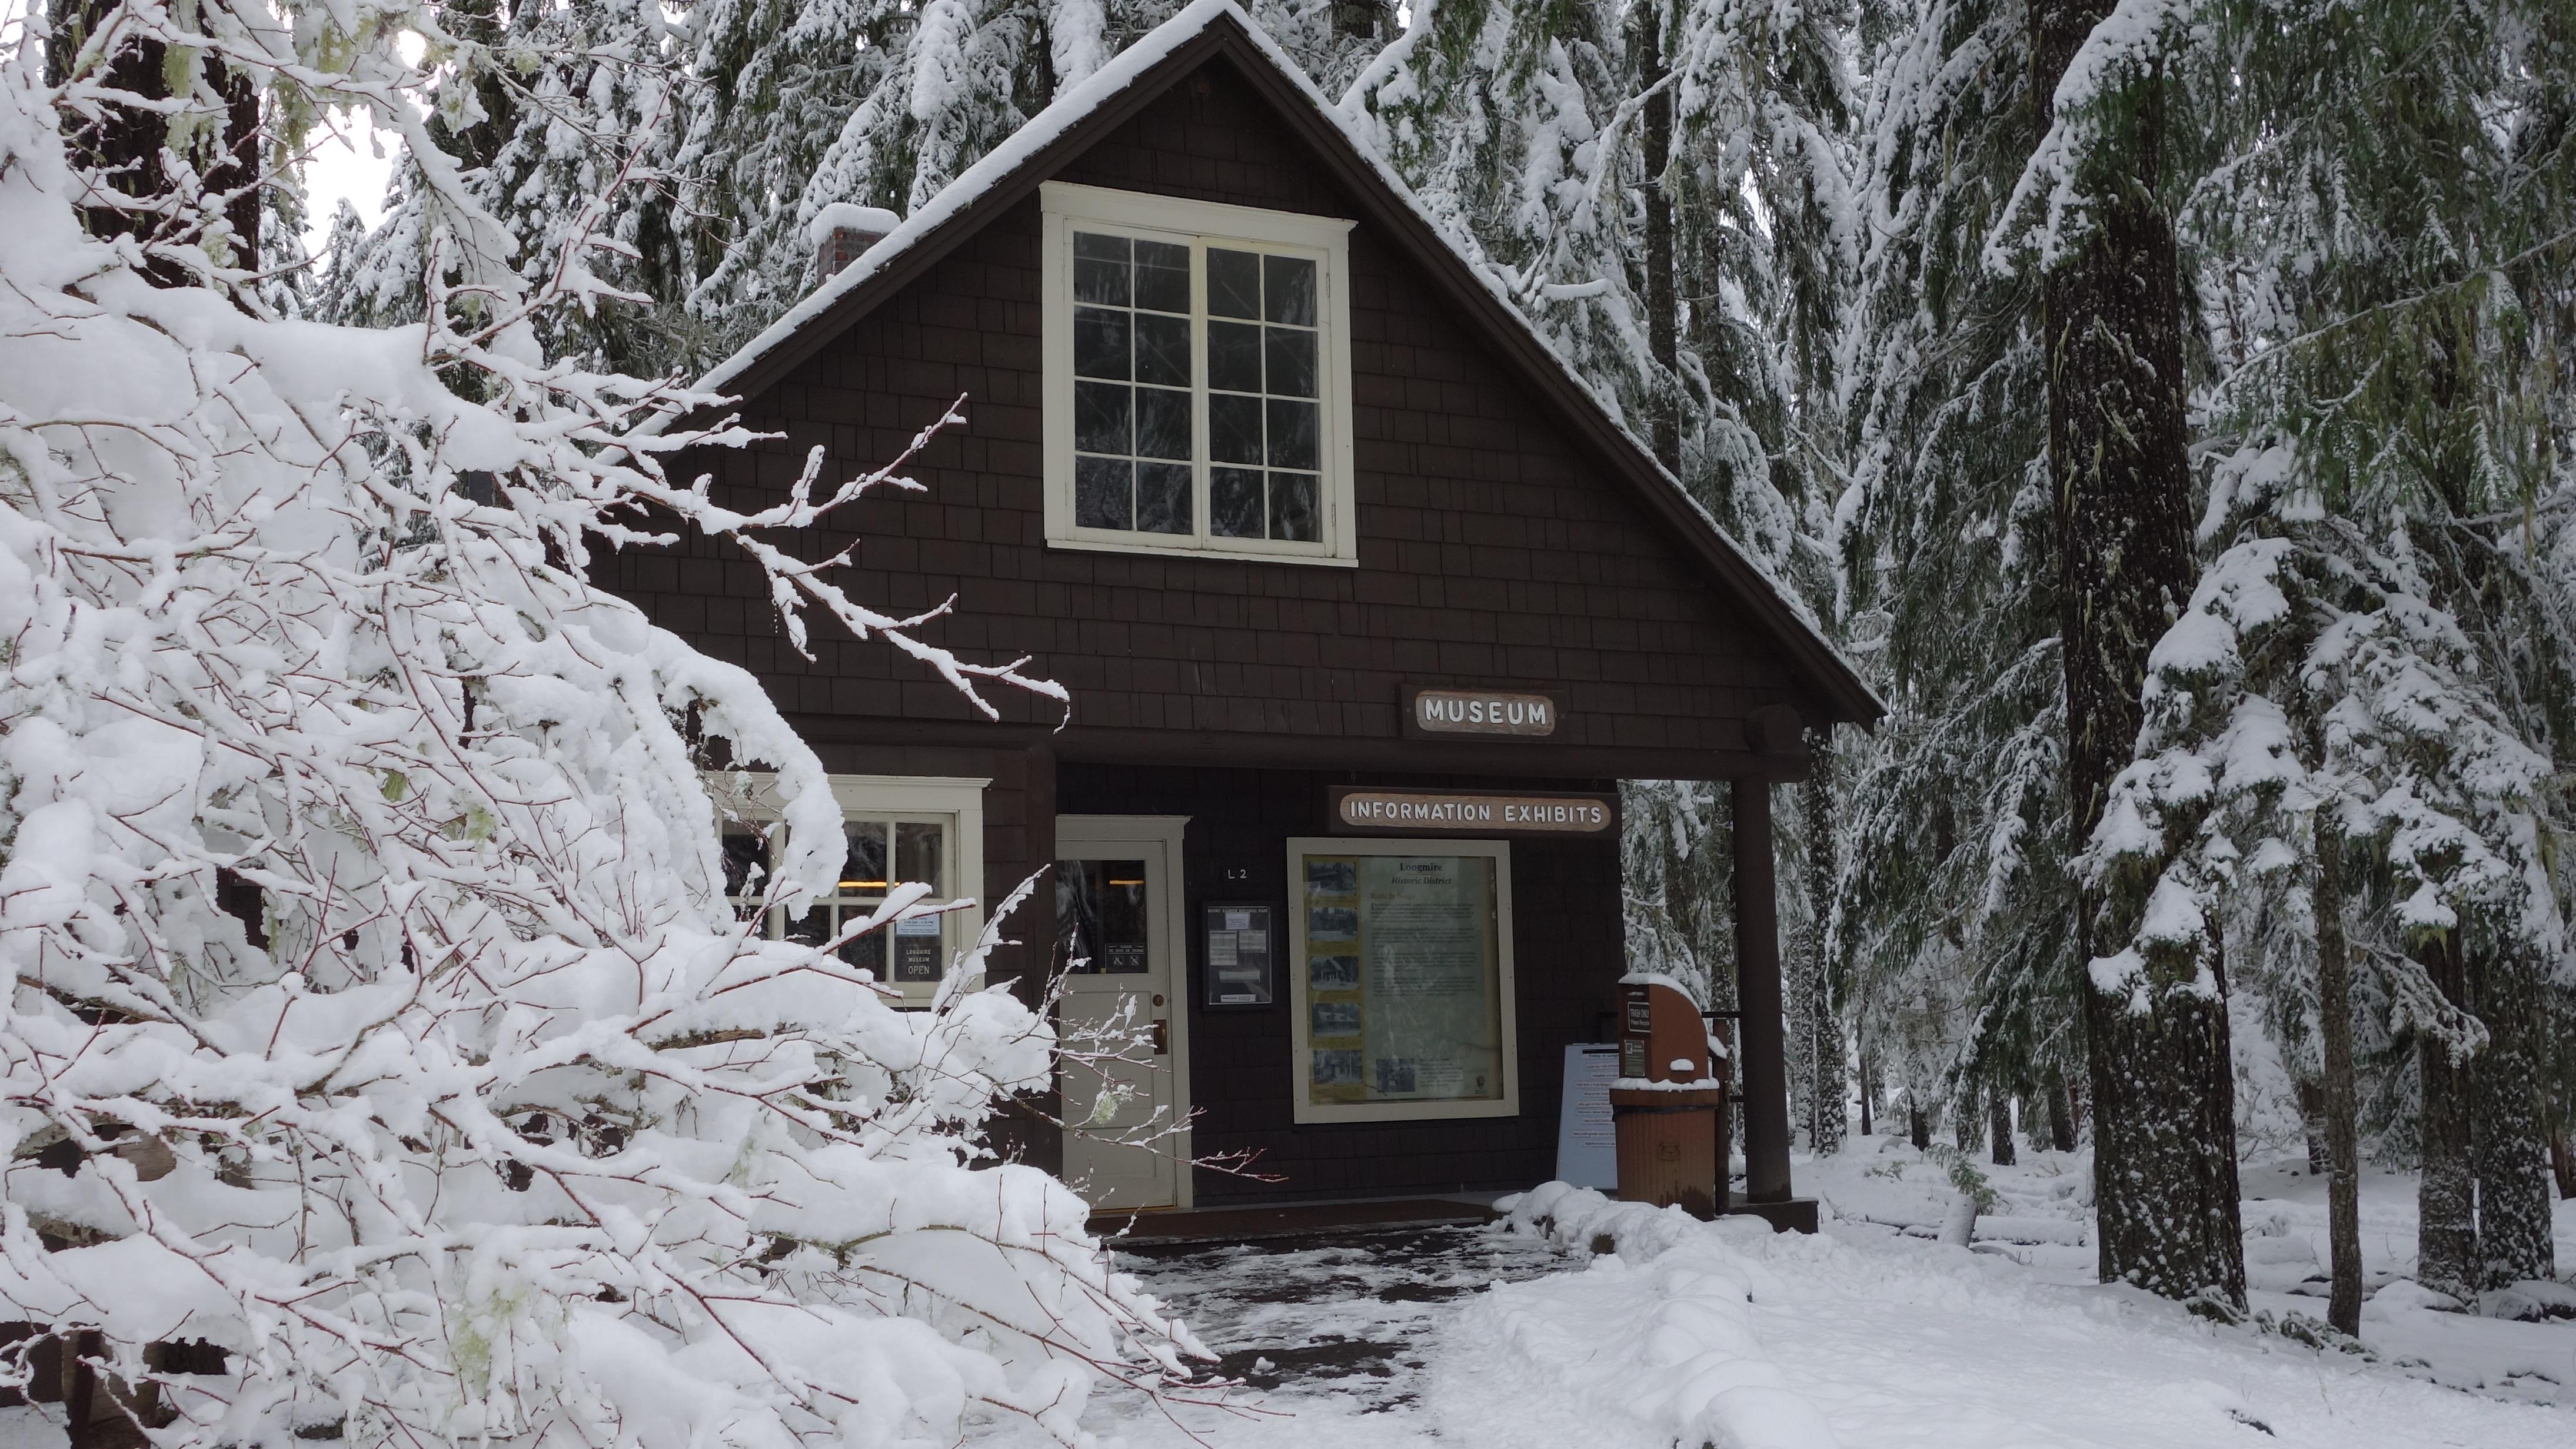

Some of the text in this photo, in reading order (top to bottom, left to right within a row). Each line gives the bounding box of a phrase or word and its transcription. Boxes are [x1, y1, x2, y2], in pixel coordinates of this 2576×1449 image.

[1425, 699, 1547, 724] MUSEUM
[1350, 801, 1602, 823] INFORMATION EXHIBITS
[1400, 863, 1442, 873] Longmire
[1228, 869, 1247, 879] L 2
[908, 966, 930, 975] OPEN
